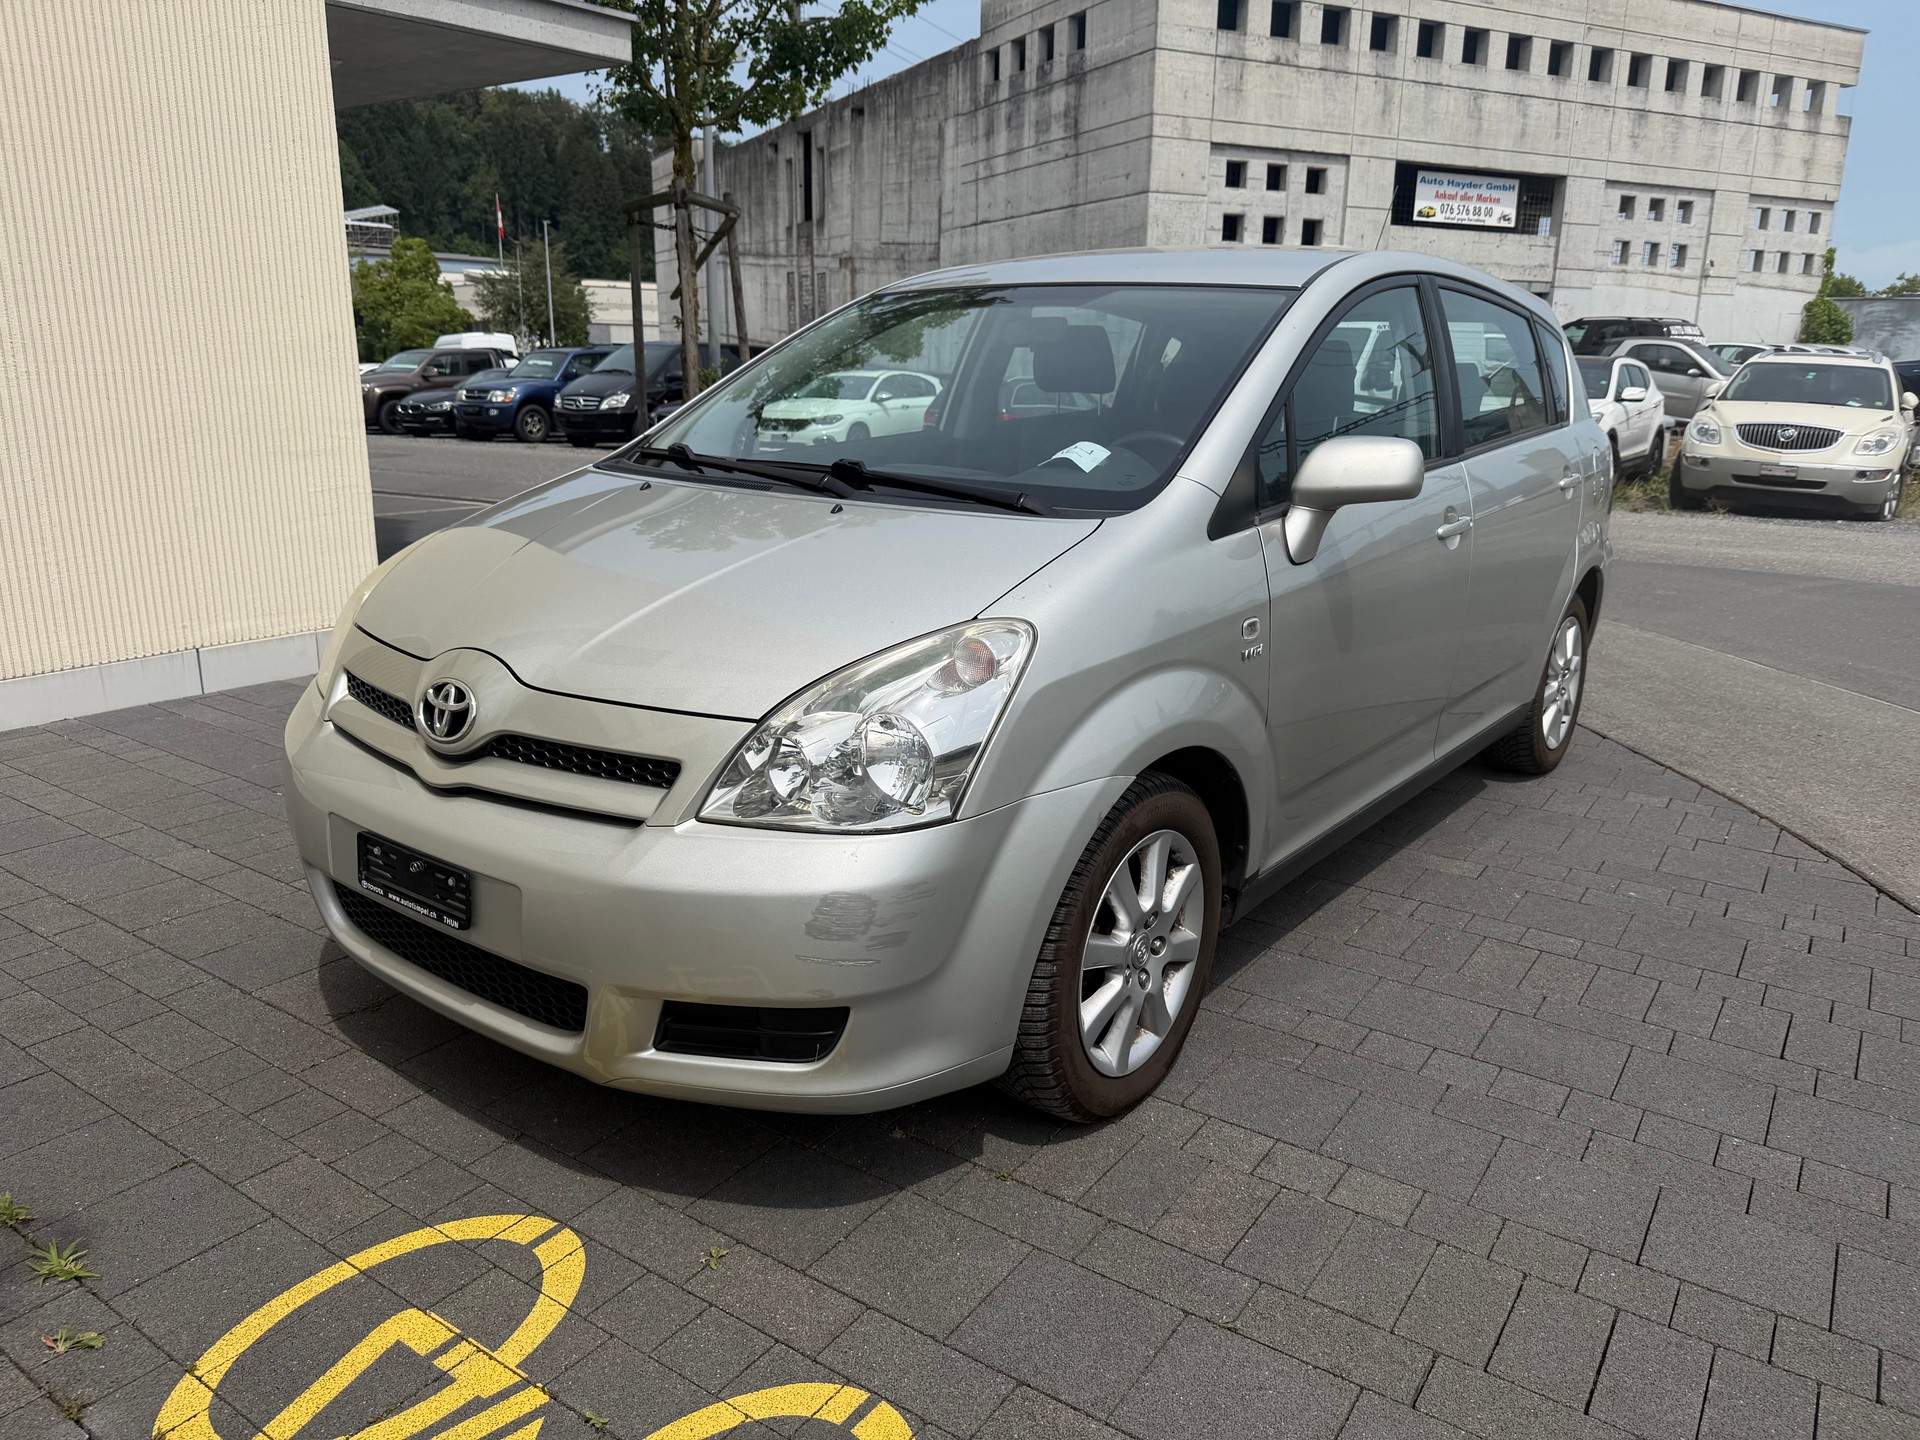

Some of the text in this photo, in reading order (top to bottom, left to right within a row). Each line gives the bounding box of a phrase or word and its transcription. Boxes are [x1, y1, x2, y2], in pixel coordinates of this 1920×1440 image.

[1419, 176, 1516, 192] Auto Hayder GmbH
[1434, 189, 1501, 204] Ankauf aller Marken
[1440, 203, 1493, 217] 076 576 88 00
[367, 883, 384, 895] TOYOTA
[443, 915, 459, 929] THUN
